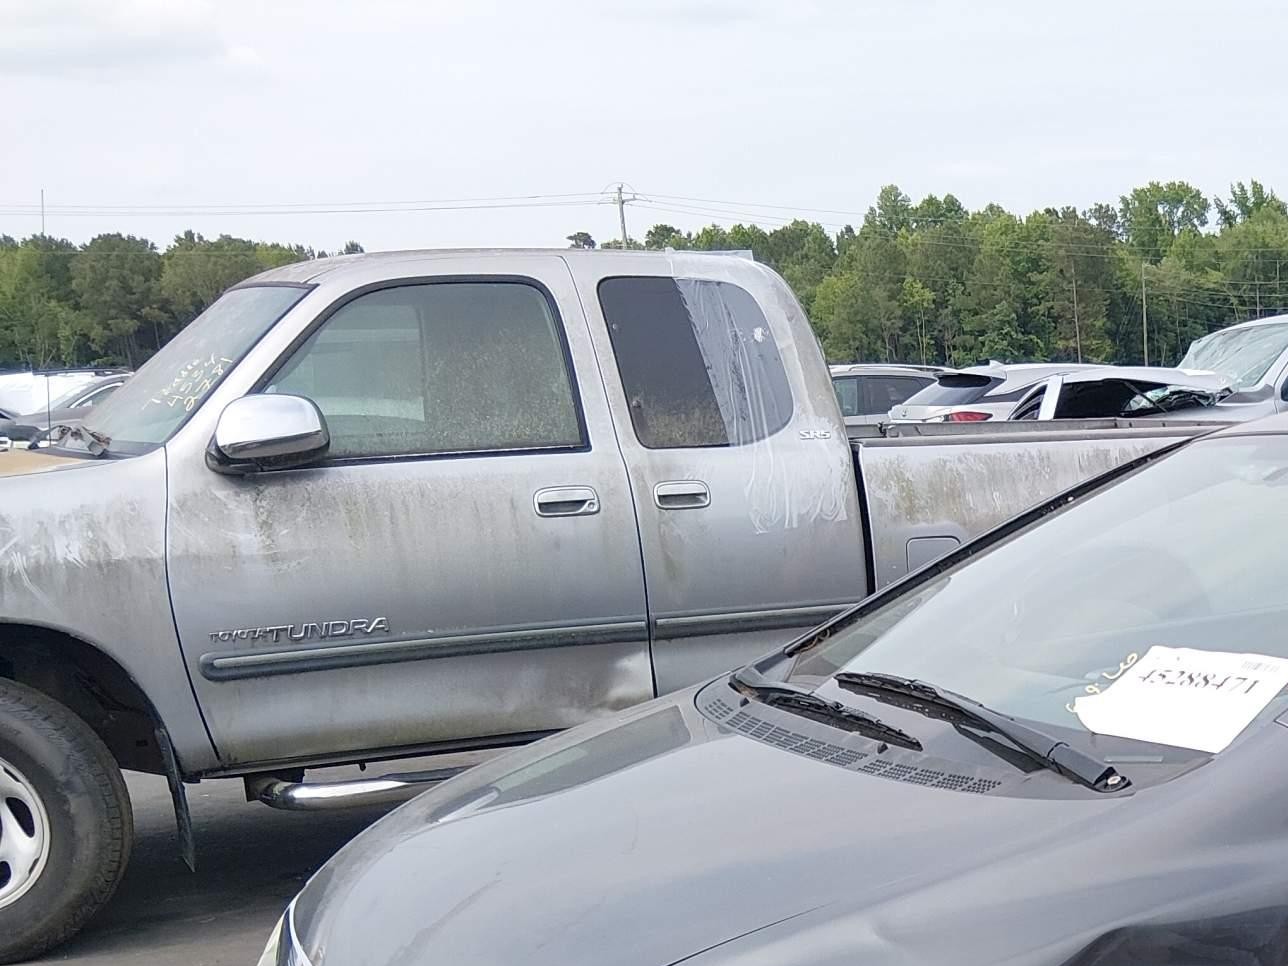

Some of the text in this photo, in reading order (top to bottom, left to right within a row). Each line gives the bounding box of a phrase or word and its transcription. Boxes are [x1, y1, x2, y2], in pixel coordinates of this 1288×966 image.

[799, 430, 832, 441] SR5
[208, 616, 391, 644] TOYOTA TUNDRA
[1138, 668, 1261, 695] 45288471
